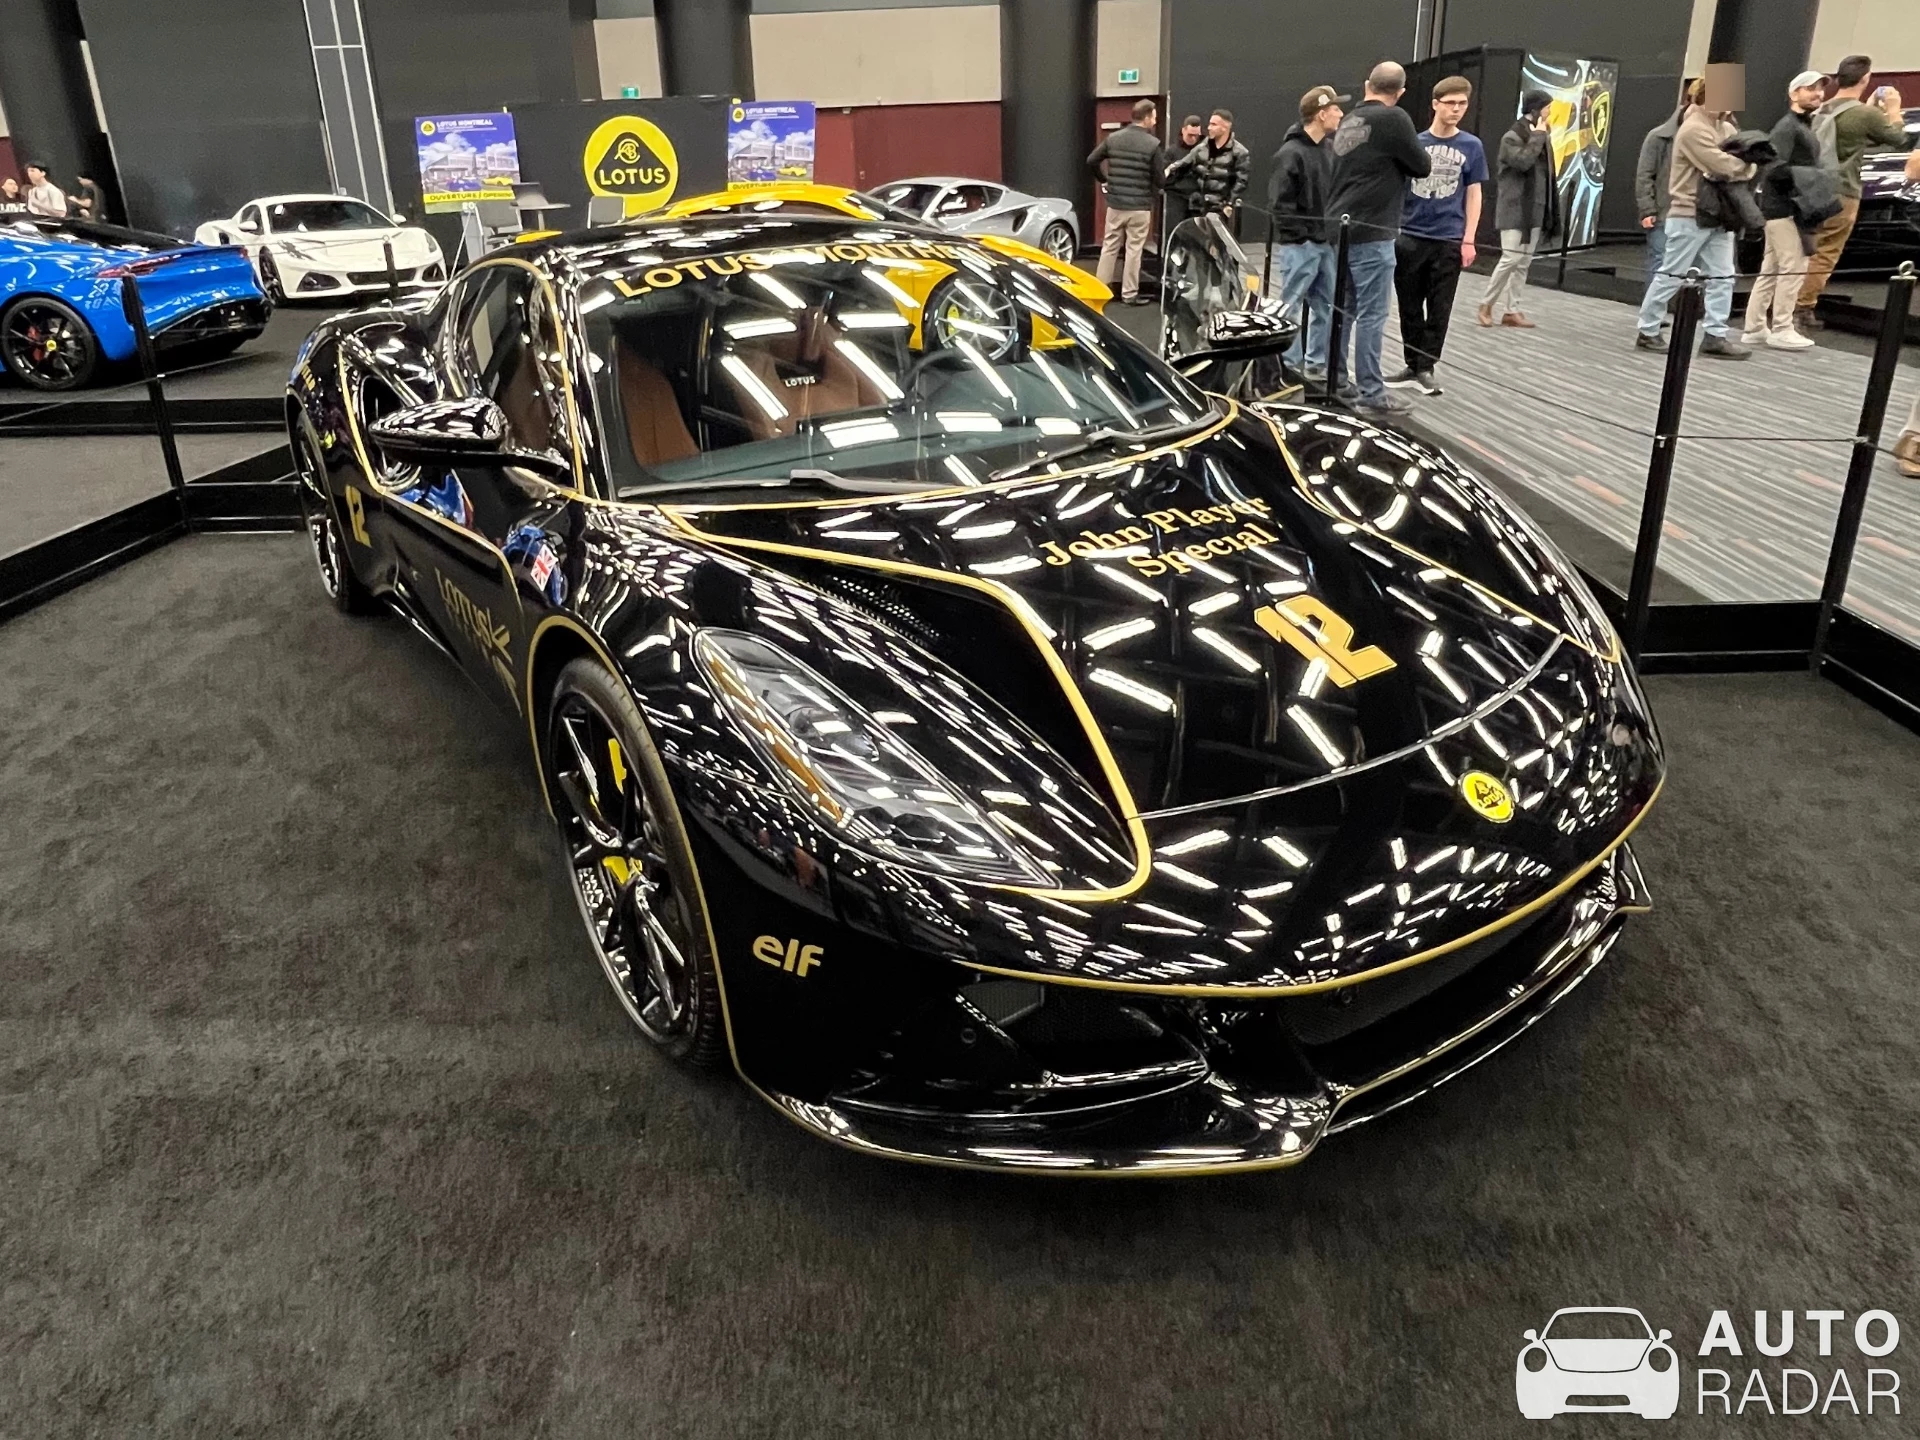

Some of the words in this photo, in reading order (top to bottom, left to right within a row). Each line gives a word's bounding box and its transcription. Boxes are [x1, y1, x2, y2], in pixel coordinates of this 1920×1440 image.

[599, 167, 666, 186] LOTUS
[613, 252, 774, 298] LOTUS
[784, 375, 816, 388] LOTUS
[1038, 524, 1154, 567] John
[1142, 496, 1272, 535] Player
[1126, 522, 1280, 578] Special
[1253, 594, 1398, 689] 12
[752, 934, 825, 978] elf
